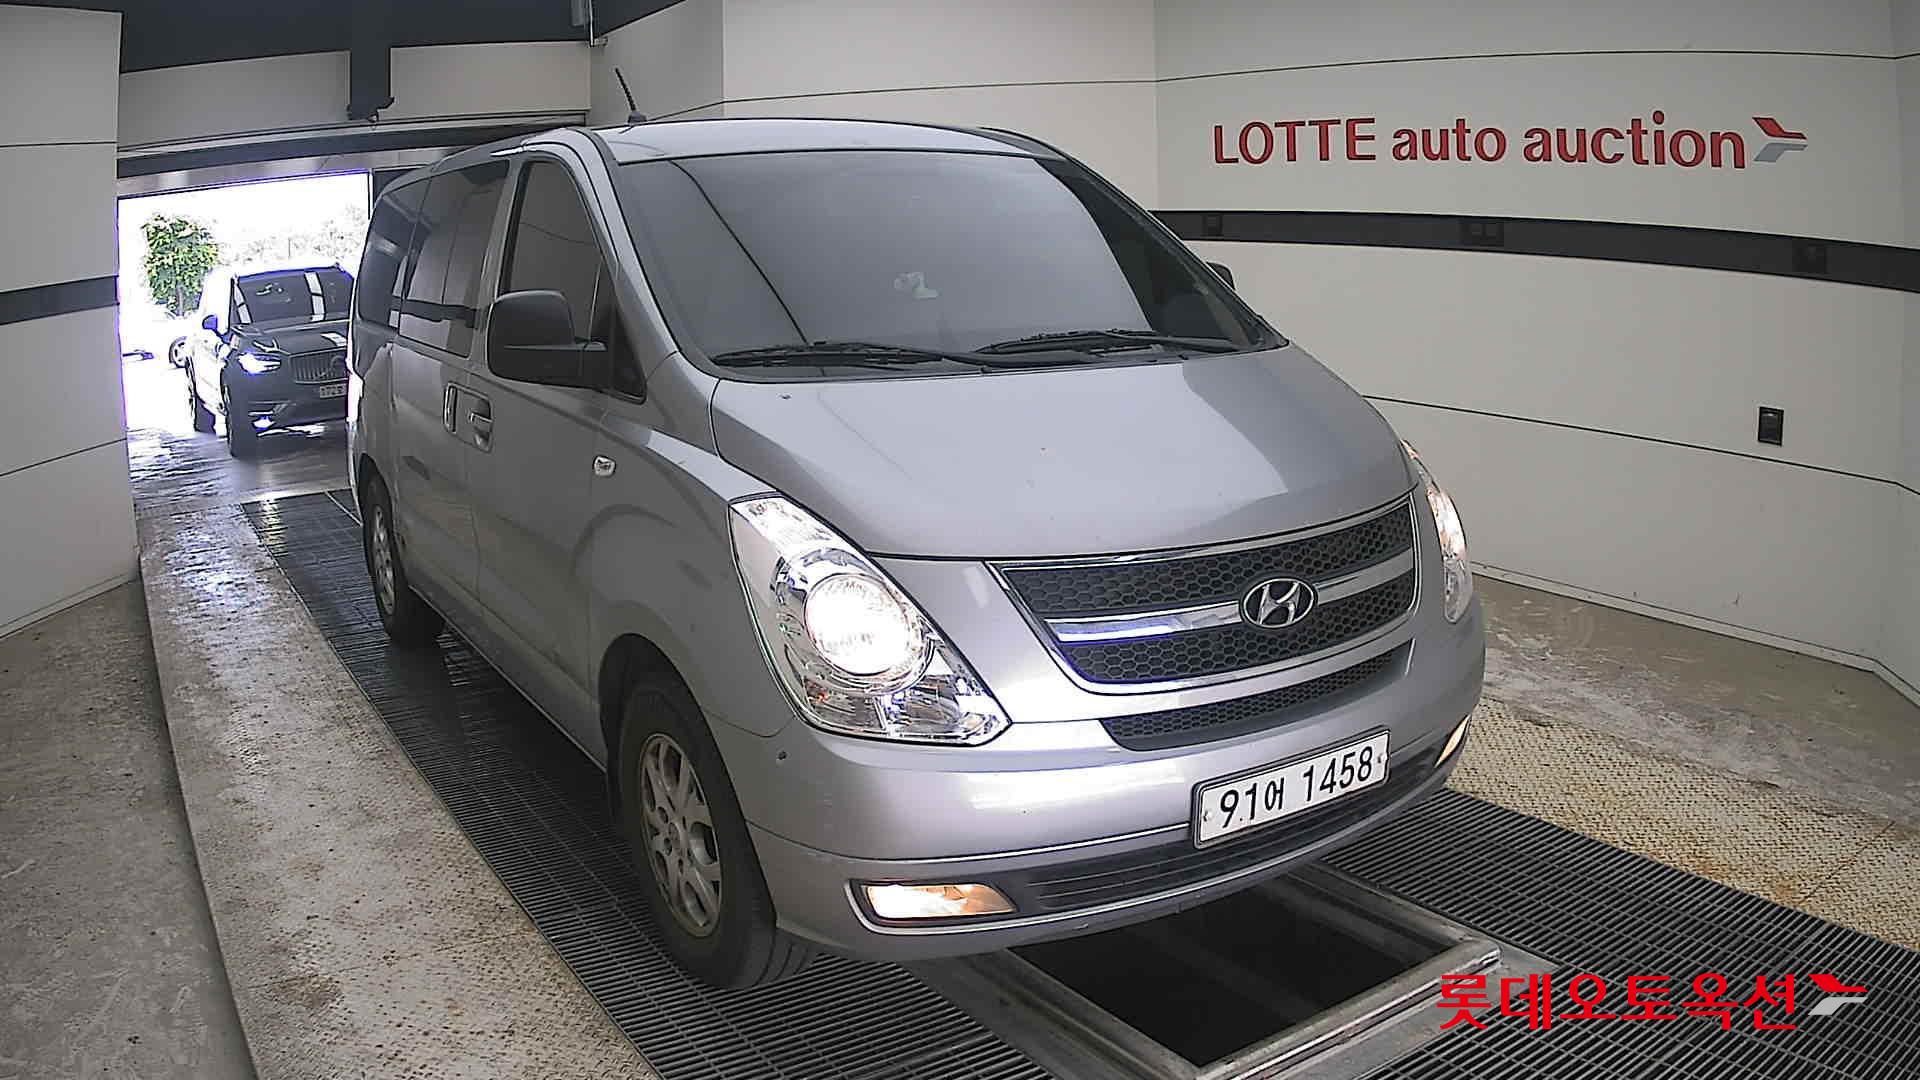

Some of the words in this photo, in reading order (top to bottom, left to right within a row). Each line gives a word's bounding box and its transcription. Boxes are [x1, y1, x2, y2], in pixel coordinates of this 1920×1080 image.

[1213, 116, 1377, 165] LOTTE
[1391, 117, 1507, 162] auto
[1522, 110, 1747, 170] auction
[1219, 776, 1285, 829] 91어
[1302, 745, 1374, 802] 1458
